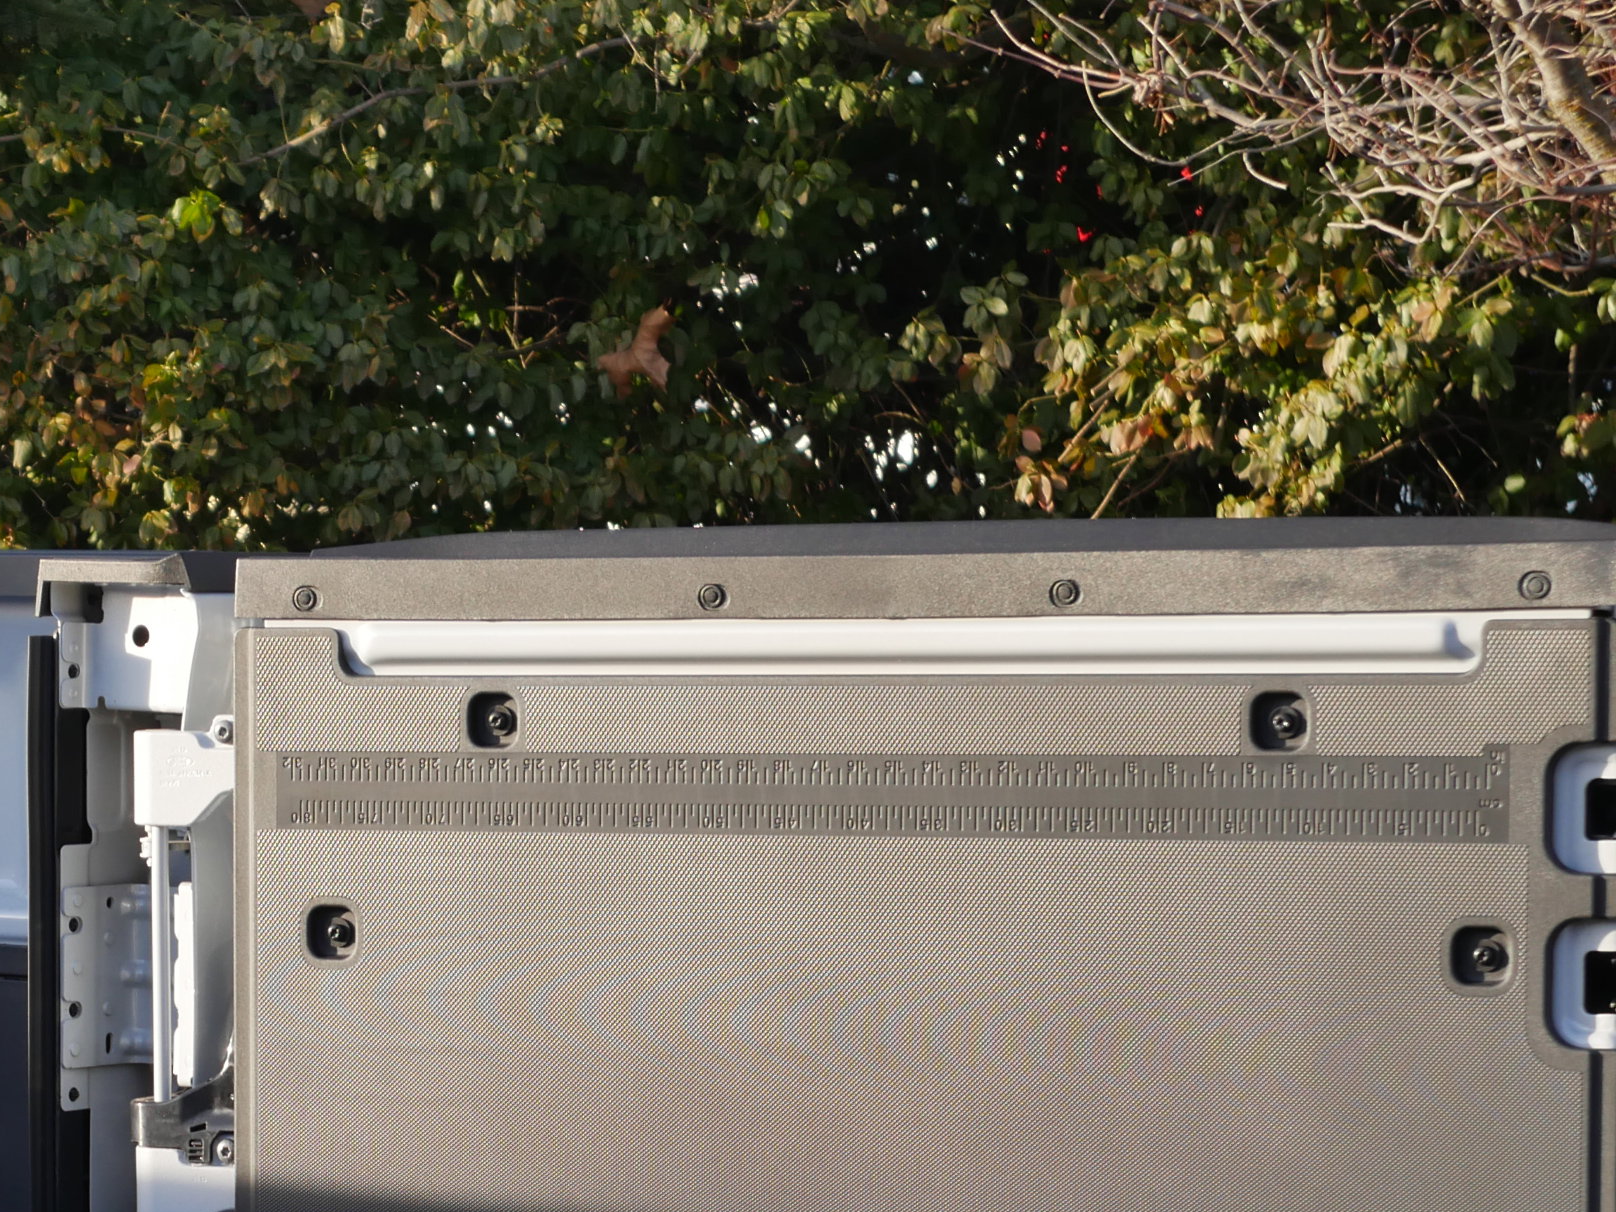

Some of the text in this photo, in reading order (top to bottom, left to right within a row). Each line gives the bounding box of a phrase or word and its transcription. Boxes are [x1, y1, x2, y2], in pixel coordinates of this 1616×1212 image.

[283, 757, 303, 769] 32
[318, 757, 336, 769] 31
[351, 757, 370, 769] 30
[385, 757, 404, 769] 29
[419, 757, 440, 769] 28
[456, 757, 474, 769] 27
[489, 758, 508, 769] 26
[523, 758, 545, 770] 25
[559, 758, 580, 770] 24
[594, 758, 616, 770] 23
[629, 759, 651, 770] 22
[667, 759, 687, 771] 21
[701, 759, 724, 771] 20
[737, 759, 756, 771] 19
[774, 760, 793, 772] 18
[811, 760, 831, 772] 17
[848, 760, 867, 772] 16
[885, 760, 904, 772] 15
[922, 760, 942, 773] 14
[960, 761, 979, 773] 13
[998, 761, 1019, 773] 12
[1039, 761, 1056, 773] 11
[1075, 761, 1095, 774] 10
[291, 812, 311, 823] 80
[358, 813, 378, 824] 75
[426, 813, 446, 825] 70
[494, 814, 514, 825] 65
[563, 815, 583, 826] 60
[633, 815, 654, 827] 55
[703, 816, 725, 827] 50
[774, 817, 797, 829] 45
[846, 818, 870, 830] 40
[920, 818, 942, 830] 35
[996, 819, 1018, 831] 30
[1070, 820, 1095, 832] 25
[1148, 821, 1172, 833] 20
[1225, 821, 1245, 834] 15
[1303, 822, 1325, 835] 10
